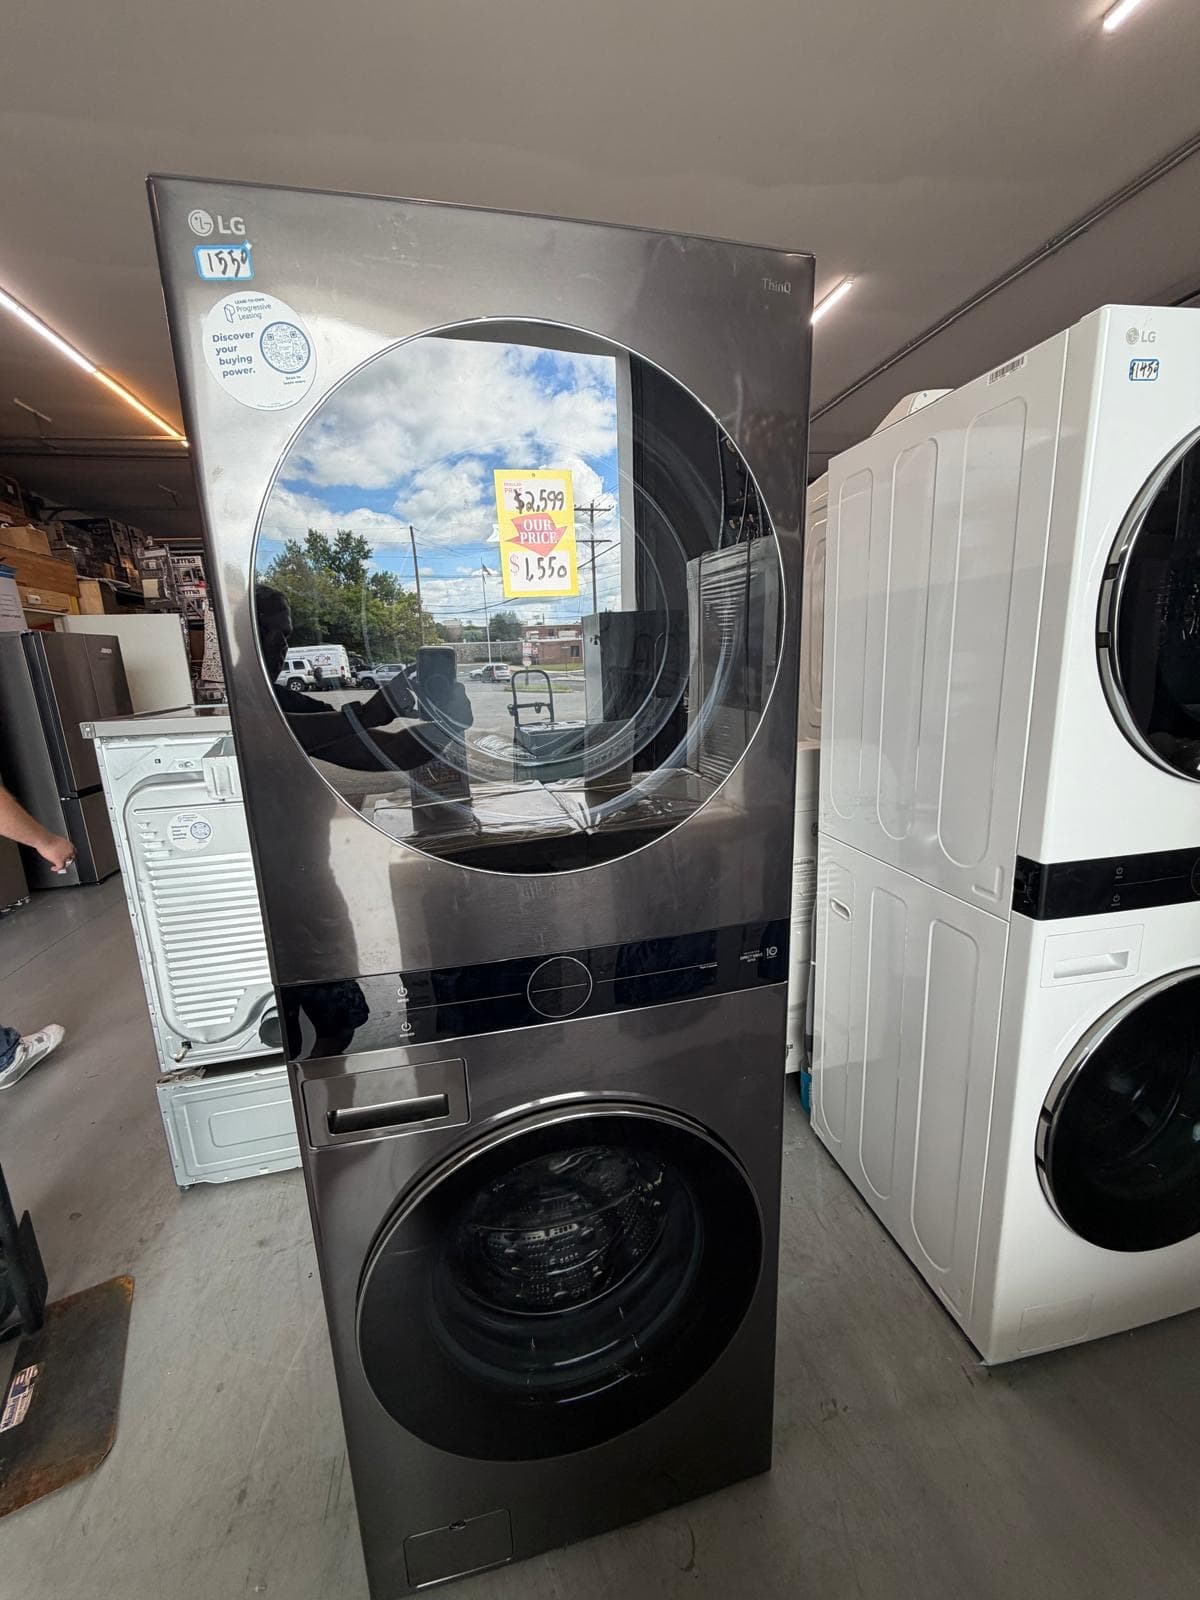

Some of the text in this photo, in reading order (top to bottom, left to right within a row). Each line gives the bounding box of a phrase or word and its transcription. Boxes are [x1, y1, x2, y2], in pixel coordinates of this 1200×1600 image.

[217, 214, 246, 235] LG
[761, 278, 792, 295] ThinQ
[236, 303, 272, 313] Progressive
[238, 312, 262, 321] Leasing
[212, 331, 255, 343] Discover
[1141, 330, 1157, 343] LG
[215, 345, 238, 356] your
[218, 354, 253, 366] buying
[222, 367, 256, 379] power.
[513, 488, 565, 515] $2,599
[523, 519, 553, 532] OUR
[519, 531, 558, 544] PRICE
